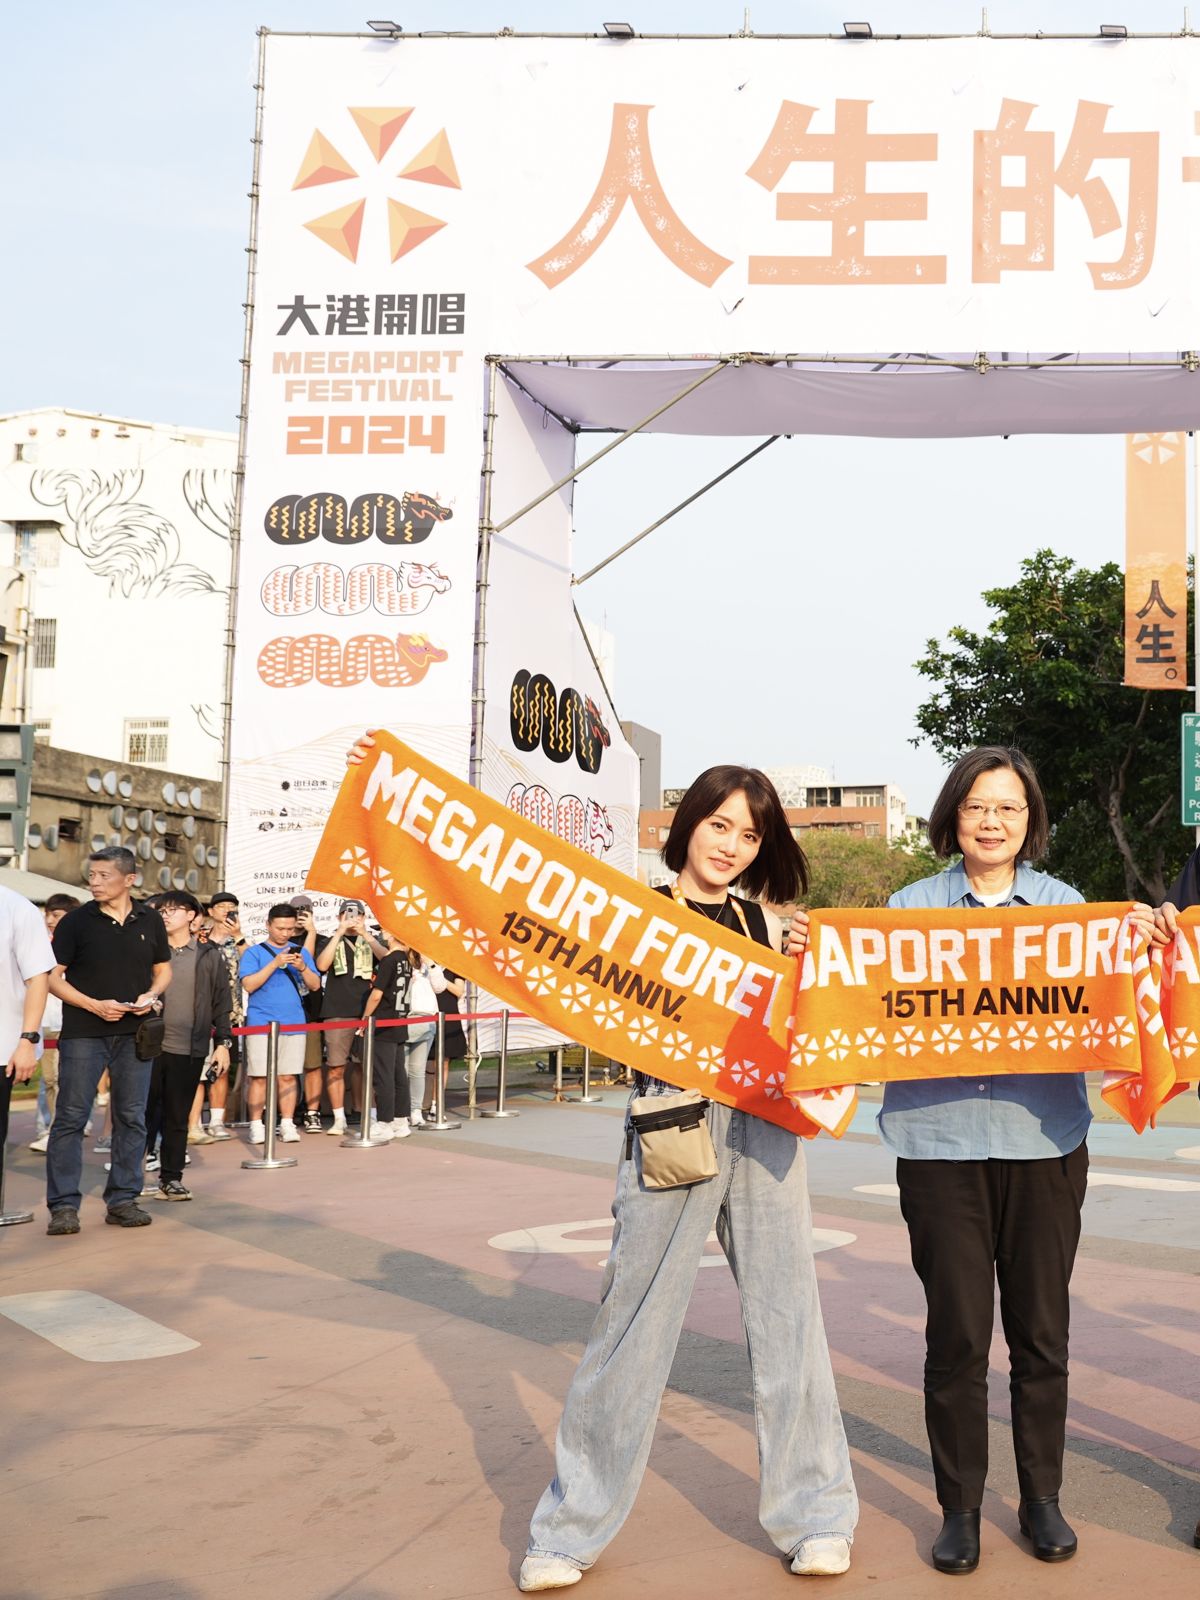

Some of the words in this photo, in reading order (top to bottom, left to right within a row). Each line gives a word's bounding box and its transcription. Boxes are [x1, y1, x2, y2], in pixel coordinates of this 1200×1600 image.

[276, 293, 466, 336] 大港開唱
[272, 350, 464, 374] MEGAPORT
[284, 379, 453, 402] FESTIVAL
[286, 415, 445, 454] 2024
[363, 751, 642, 954] MEGAPORT
[312, 898, 328, 907] oie
[499, 911, 580, 969] 15TH
[576, 954, 688, 1023] ANNIV.
[881, 988, 965, 1018] 15TH
[973, 986, 1089, 1016] ANNIV.
